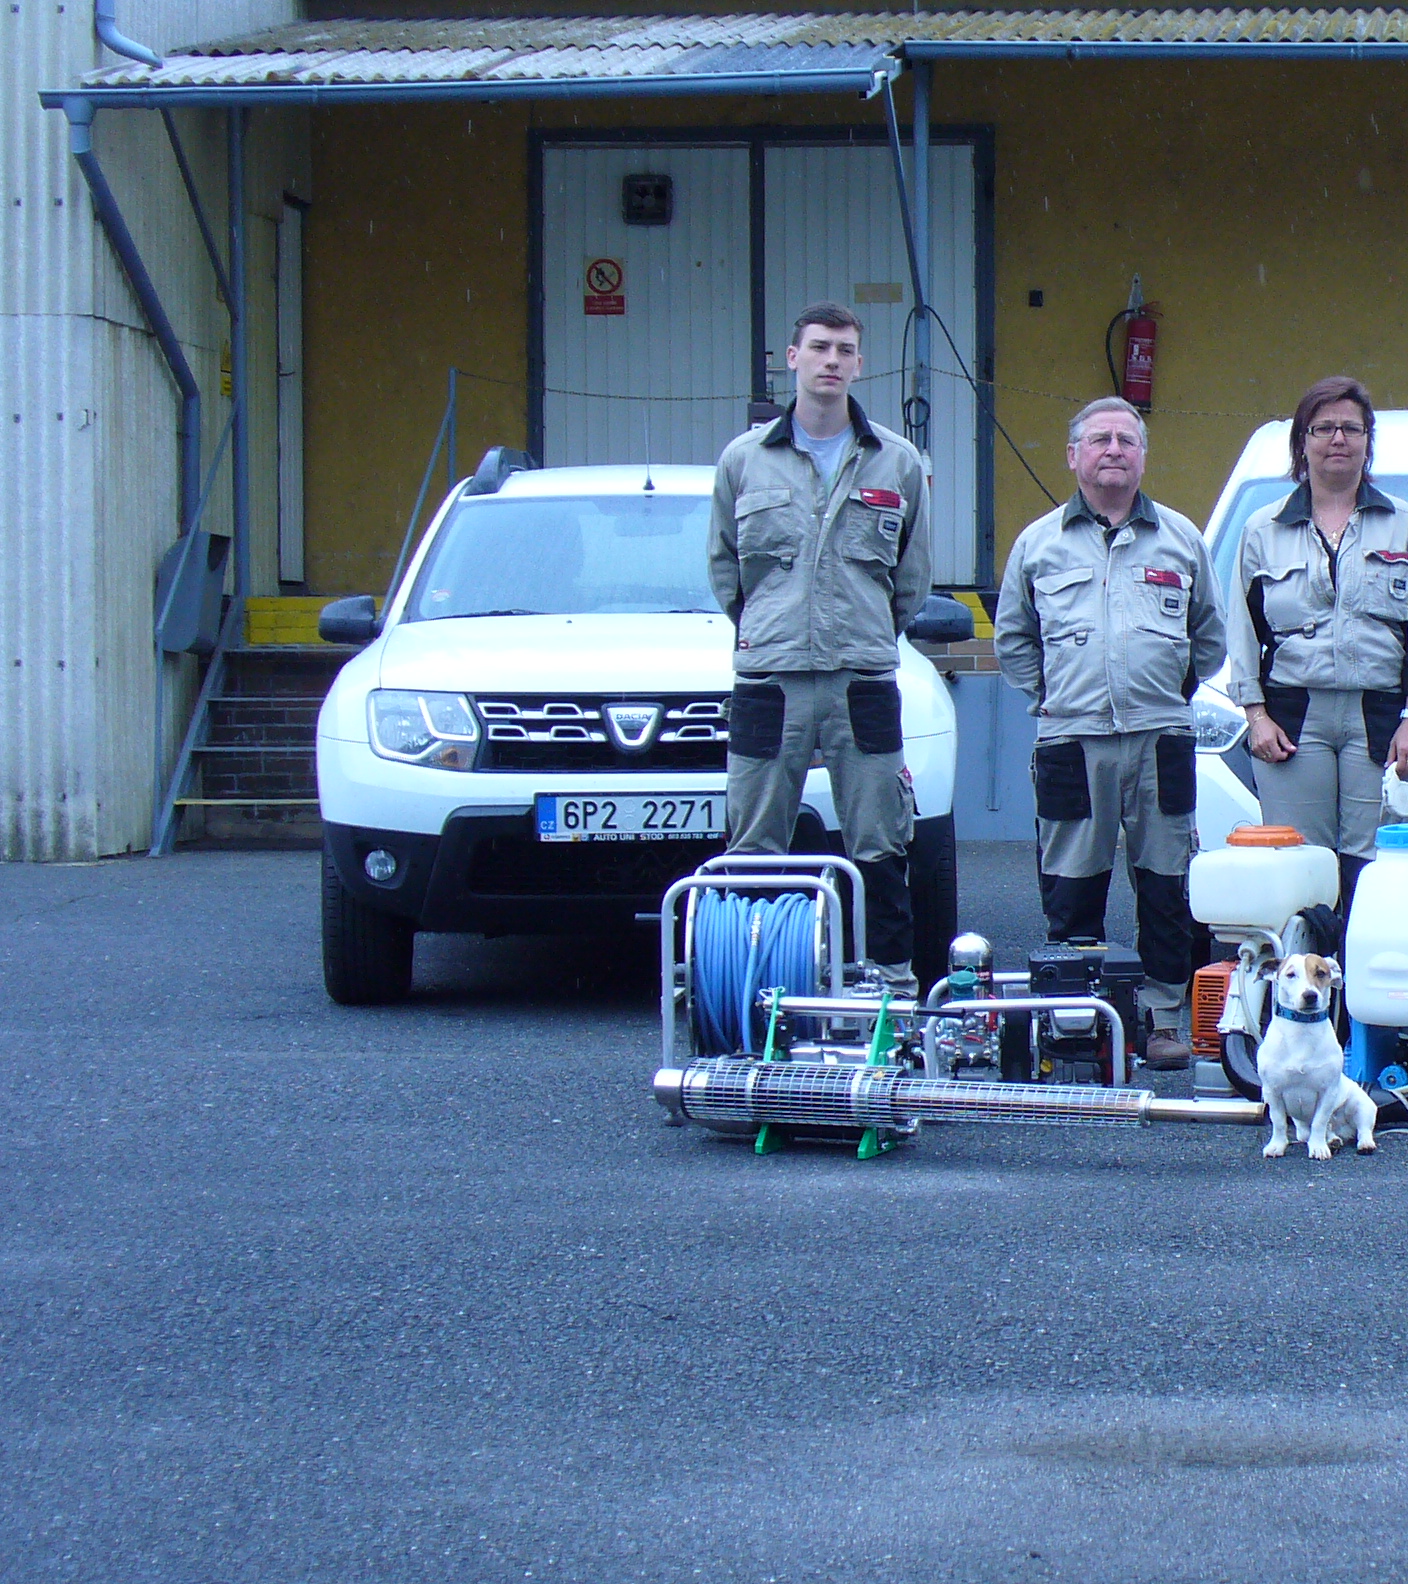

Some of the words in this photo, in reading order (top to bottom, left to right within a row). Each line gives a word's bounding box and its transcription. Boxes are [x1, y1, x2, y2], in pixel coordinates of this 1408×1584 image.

[616, 713, 648, 721] DACIA
[563, 800, 617, 829] 6P2
[642, 799, 713, 829] 2271
[540, 820, 555, 830] CZ
[593, 833, 617, 842] AUTO
[619, 833, 636, 841] UNI
[640, 833, 664, 841] STOD
